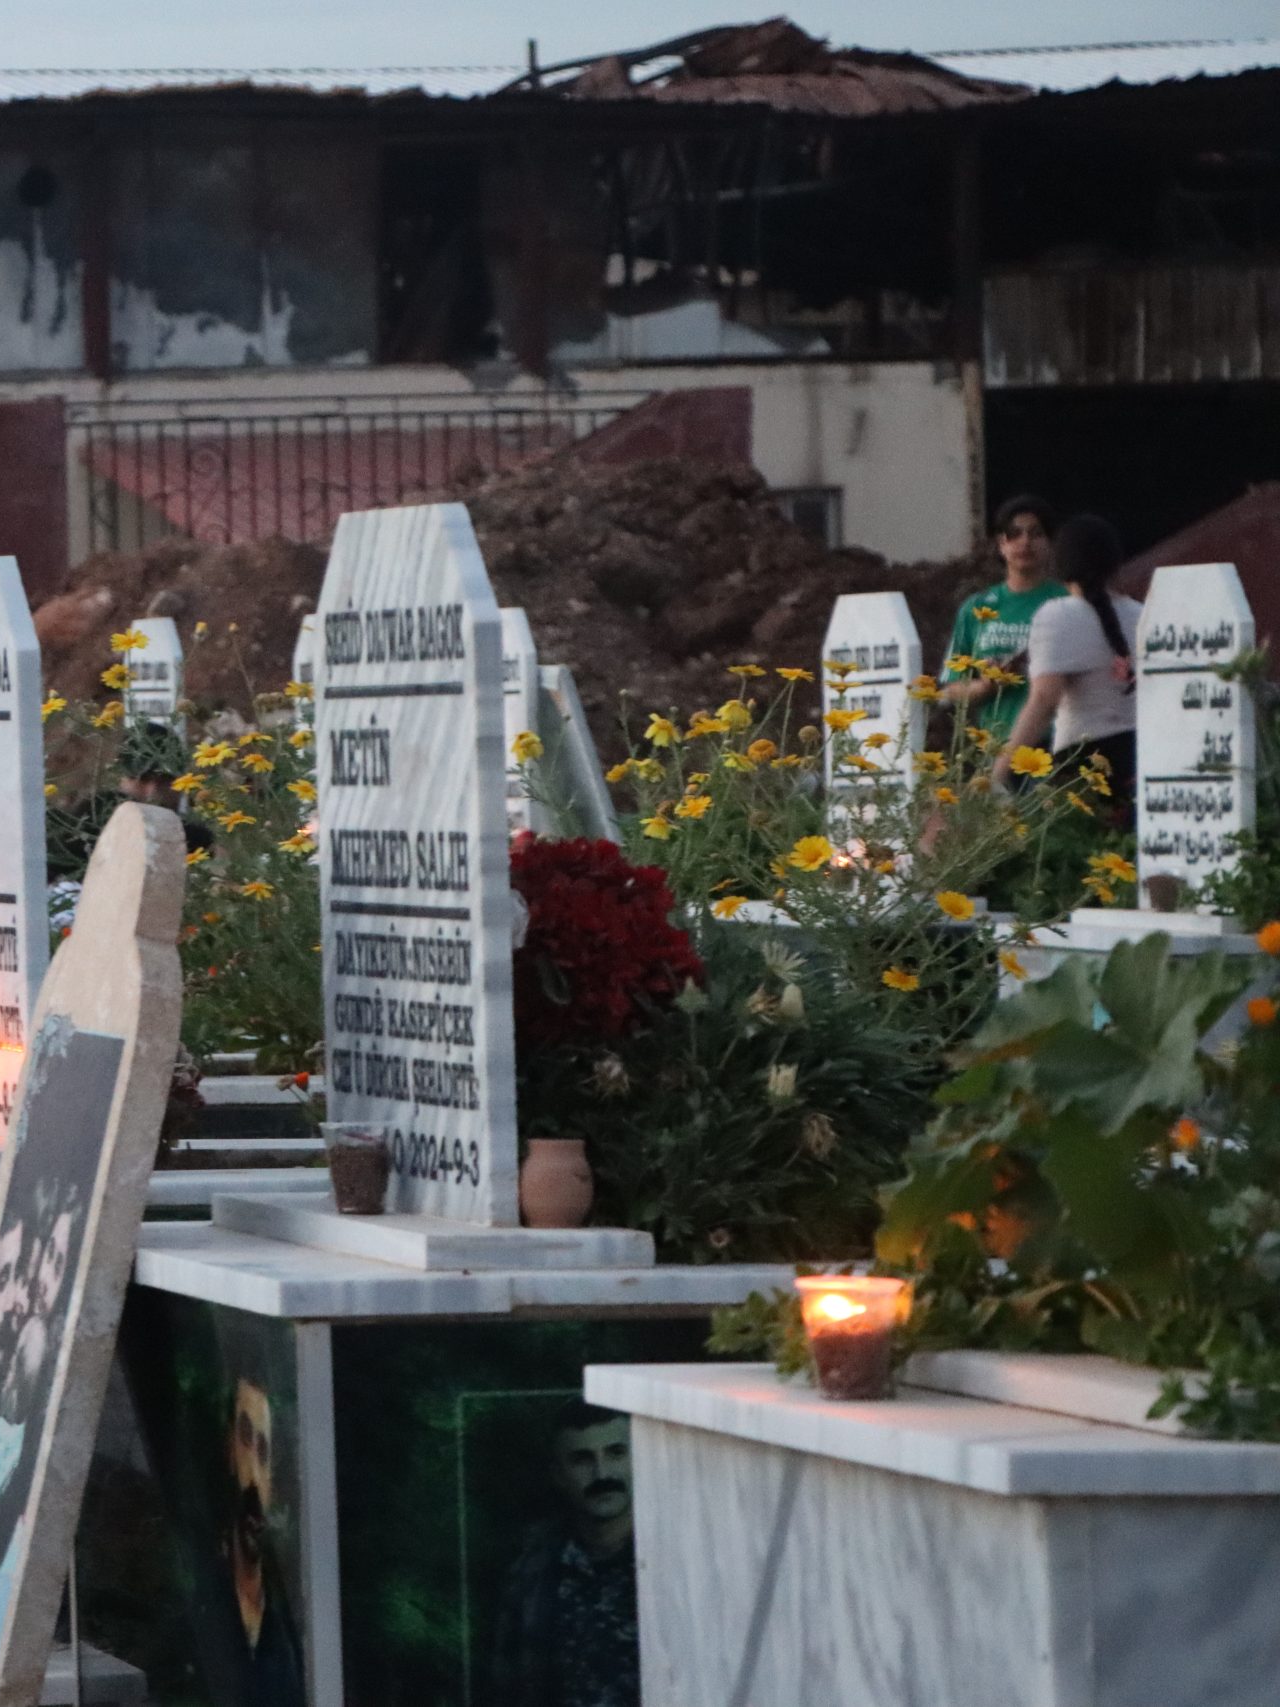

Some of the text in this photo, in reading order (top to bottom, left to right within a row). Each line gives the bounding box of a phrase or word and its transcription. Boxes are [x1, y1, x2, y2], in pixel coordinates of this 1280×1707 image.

[330, 713, 390, 786] METÎN
[330, 828, 470, 891] MIHEMED SALIH
